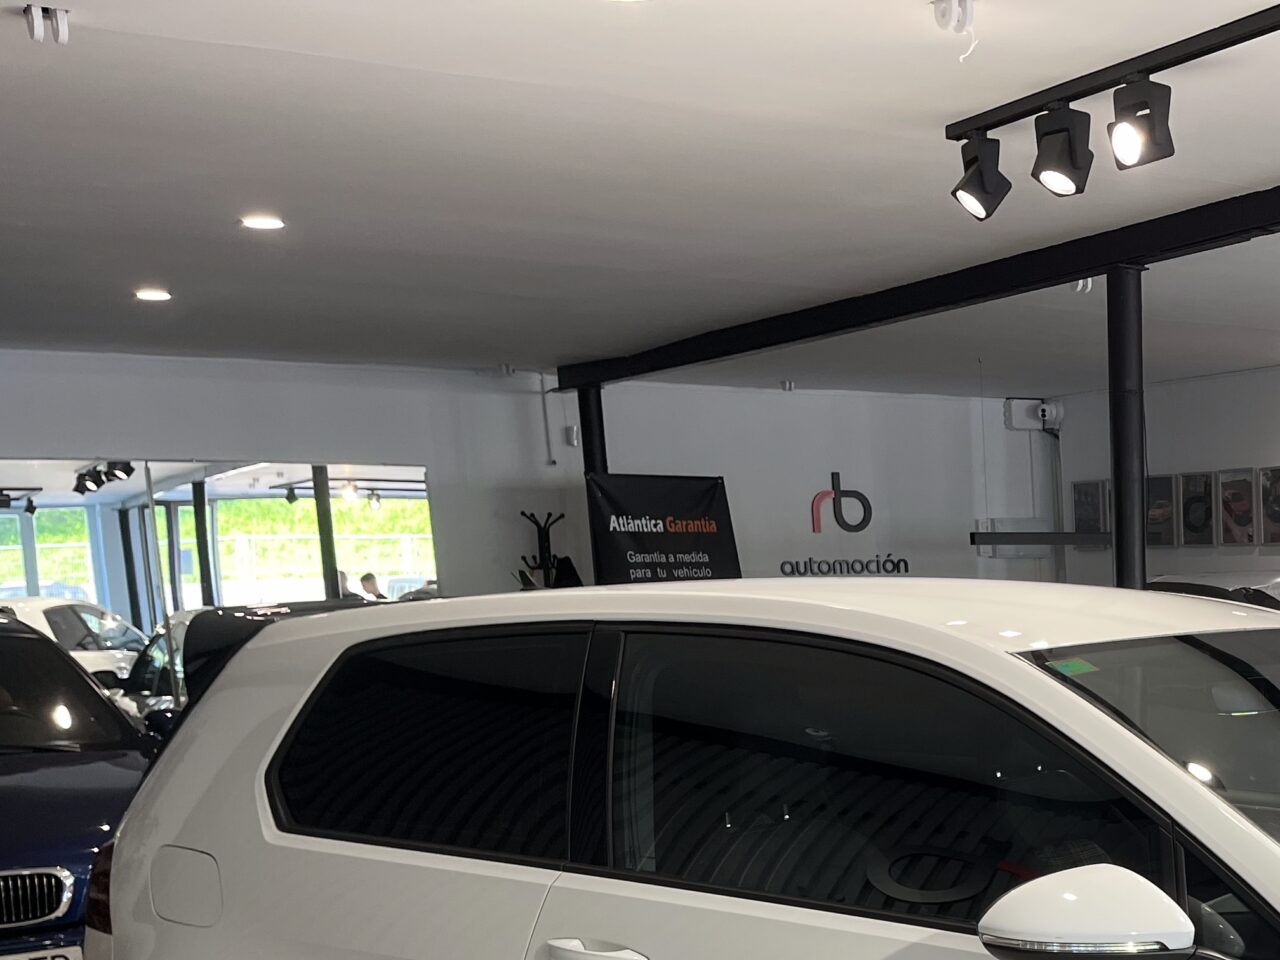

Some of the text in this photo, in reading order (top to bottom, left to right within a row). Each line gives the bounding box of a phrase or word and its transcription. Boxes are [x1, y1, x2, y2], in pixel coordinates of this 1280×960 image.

[609, 514, 664, 532] Atlántica
[669, 553, 674, 562] a
[676, 552, 709, 562] medida
[780, 553, 909, 576] automoción
[630, 568, 652, 580] para
[657, 567, 666, 577] tu
